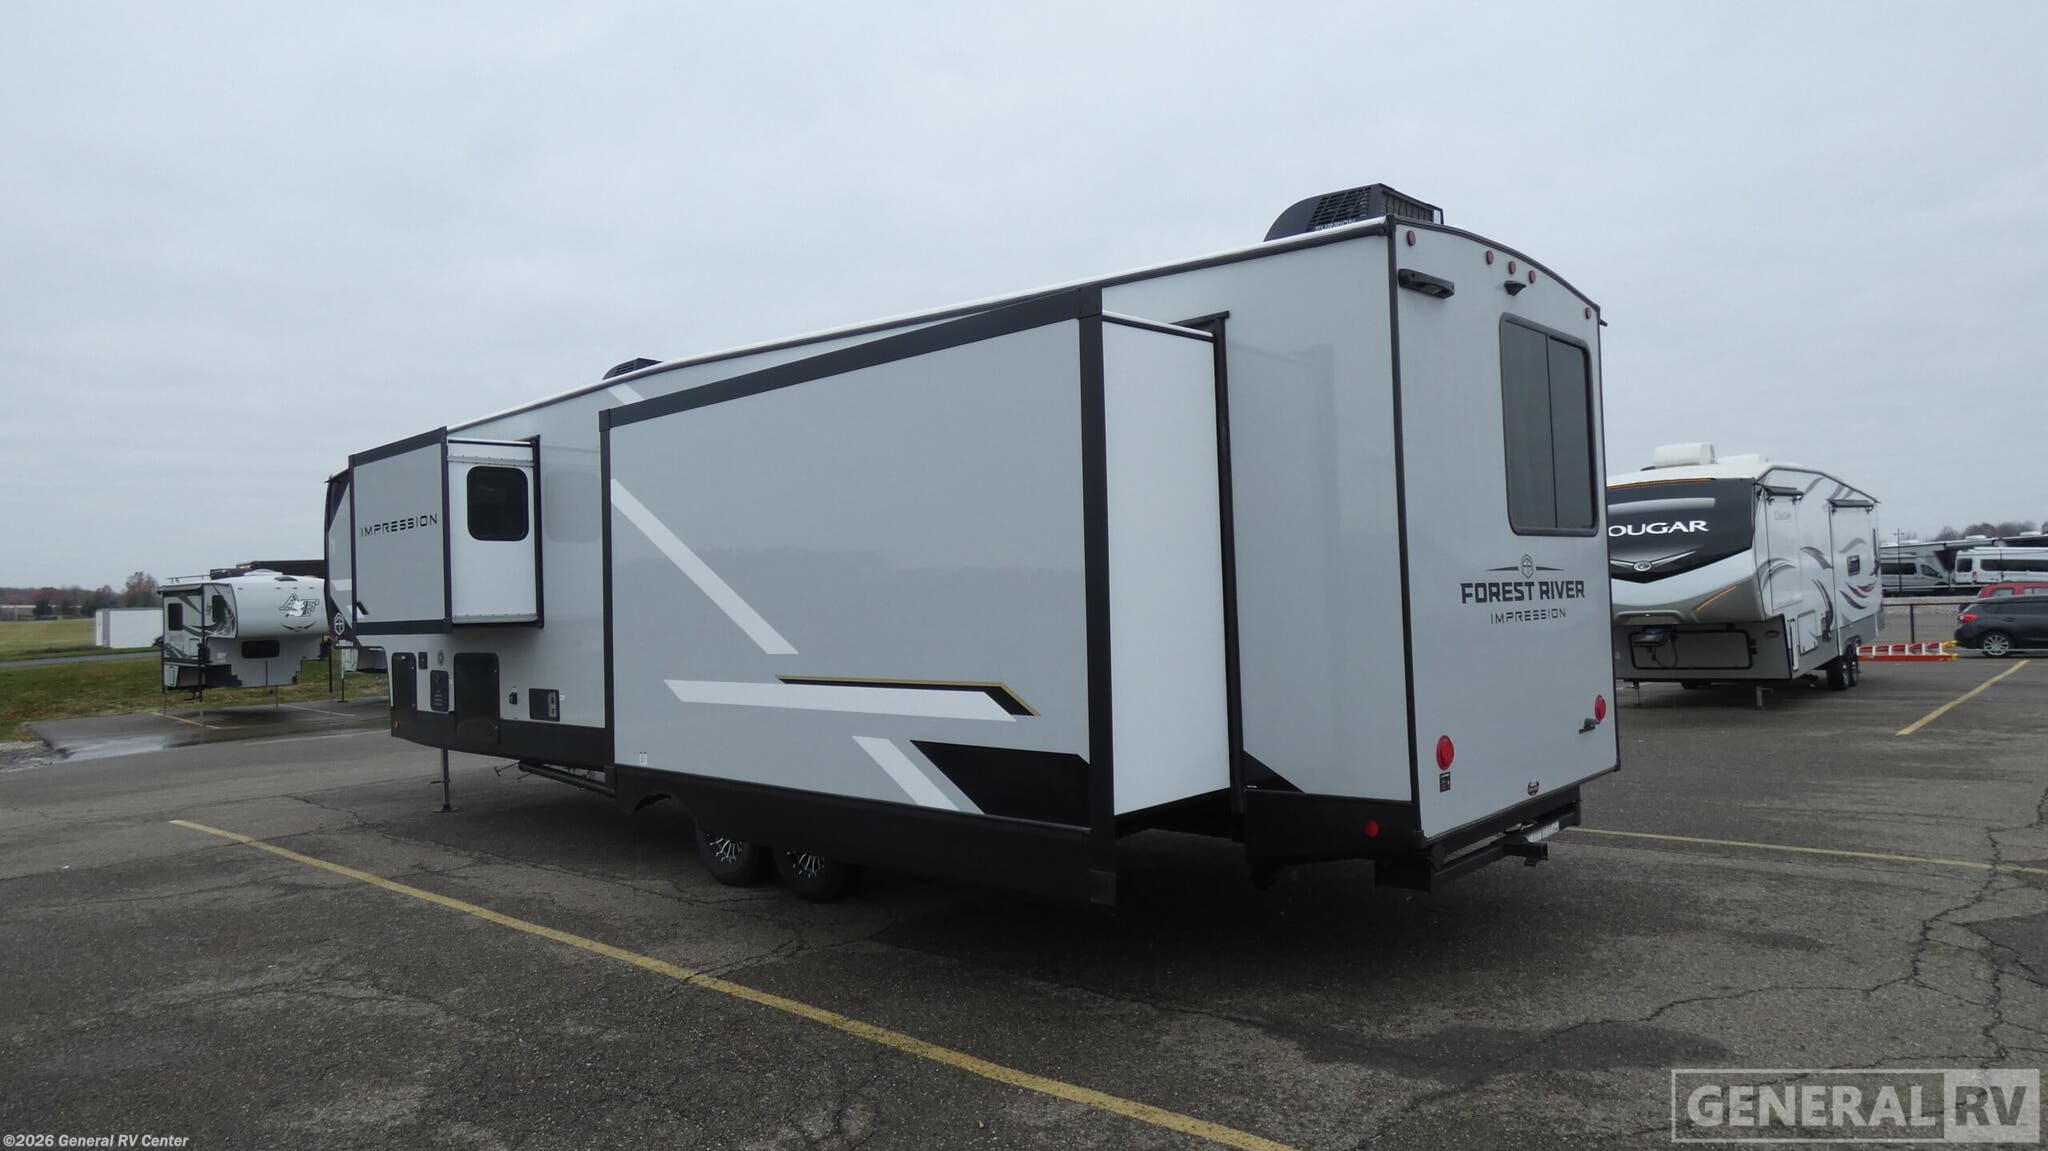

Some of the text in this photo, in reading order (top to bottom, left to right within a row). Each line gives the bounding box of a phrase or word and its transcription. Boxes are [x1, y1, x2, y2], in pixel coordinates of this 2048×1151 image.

[360, 513, 438, 538] IMPRESSION
[1608, 520, 1709, 537] OUGAR
[1460, 580, 1585, 604] FOREST RIVER
[1490, 608, 1567, 625] IMPRESSION
